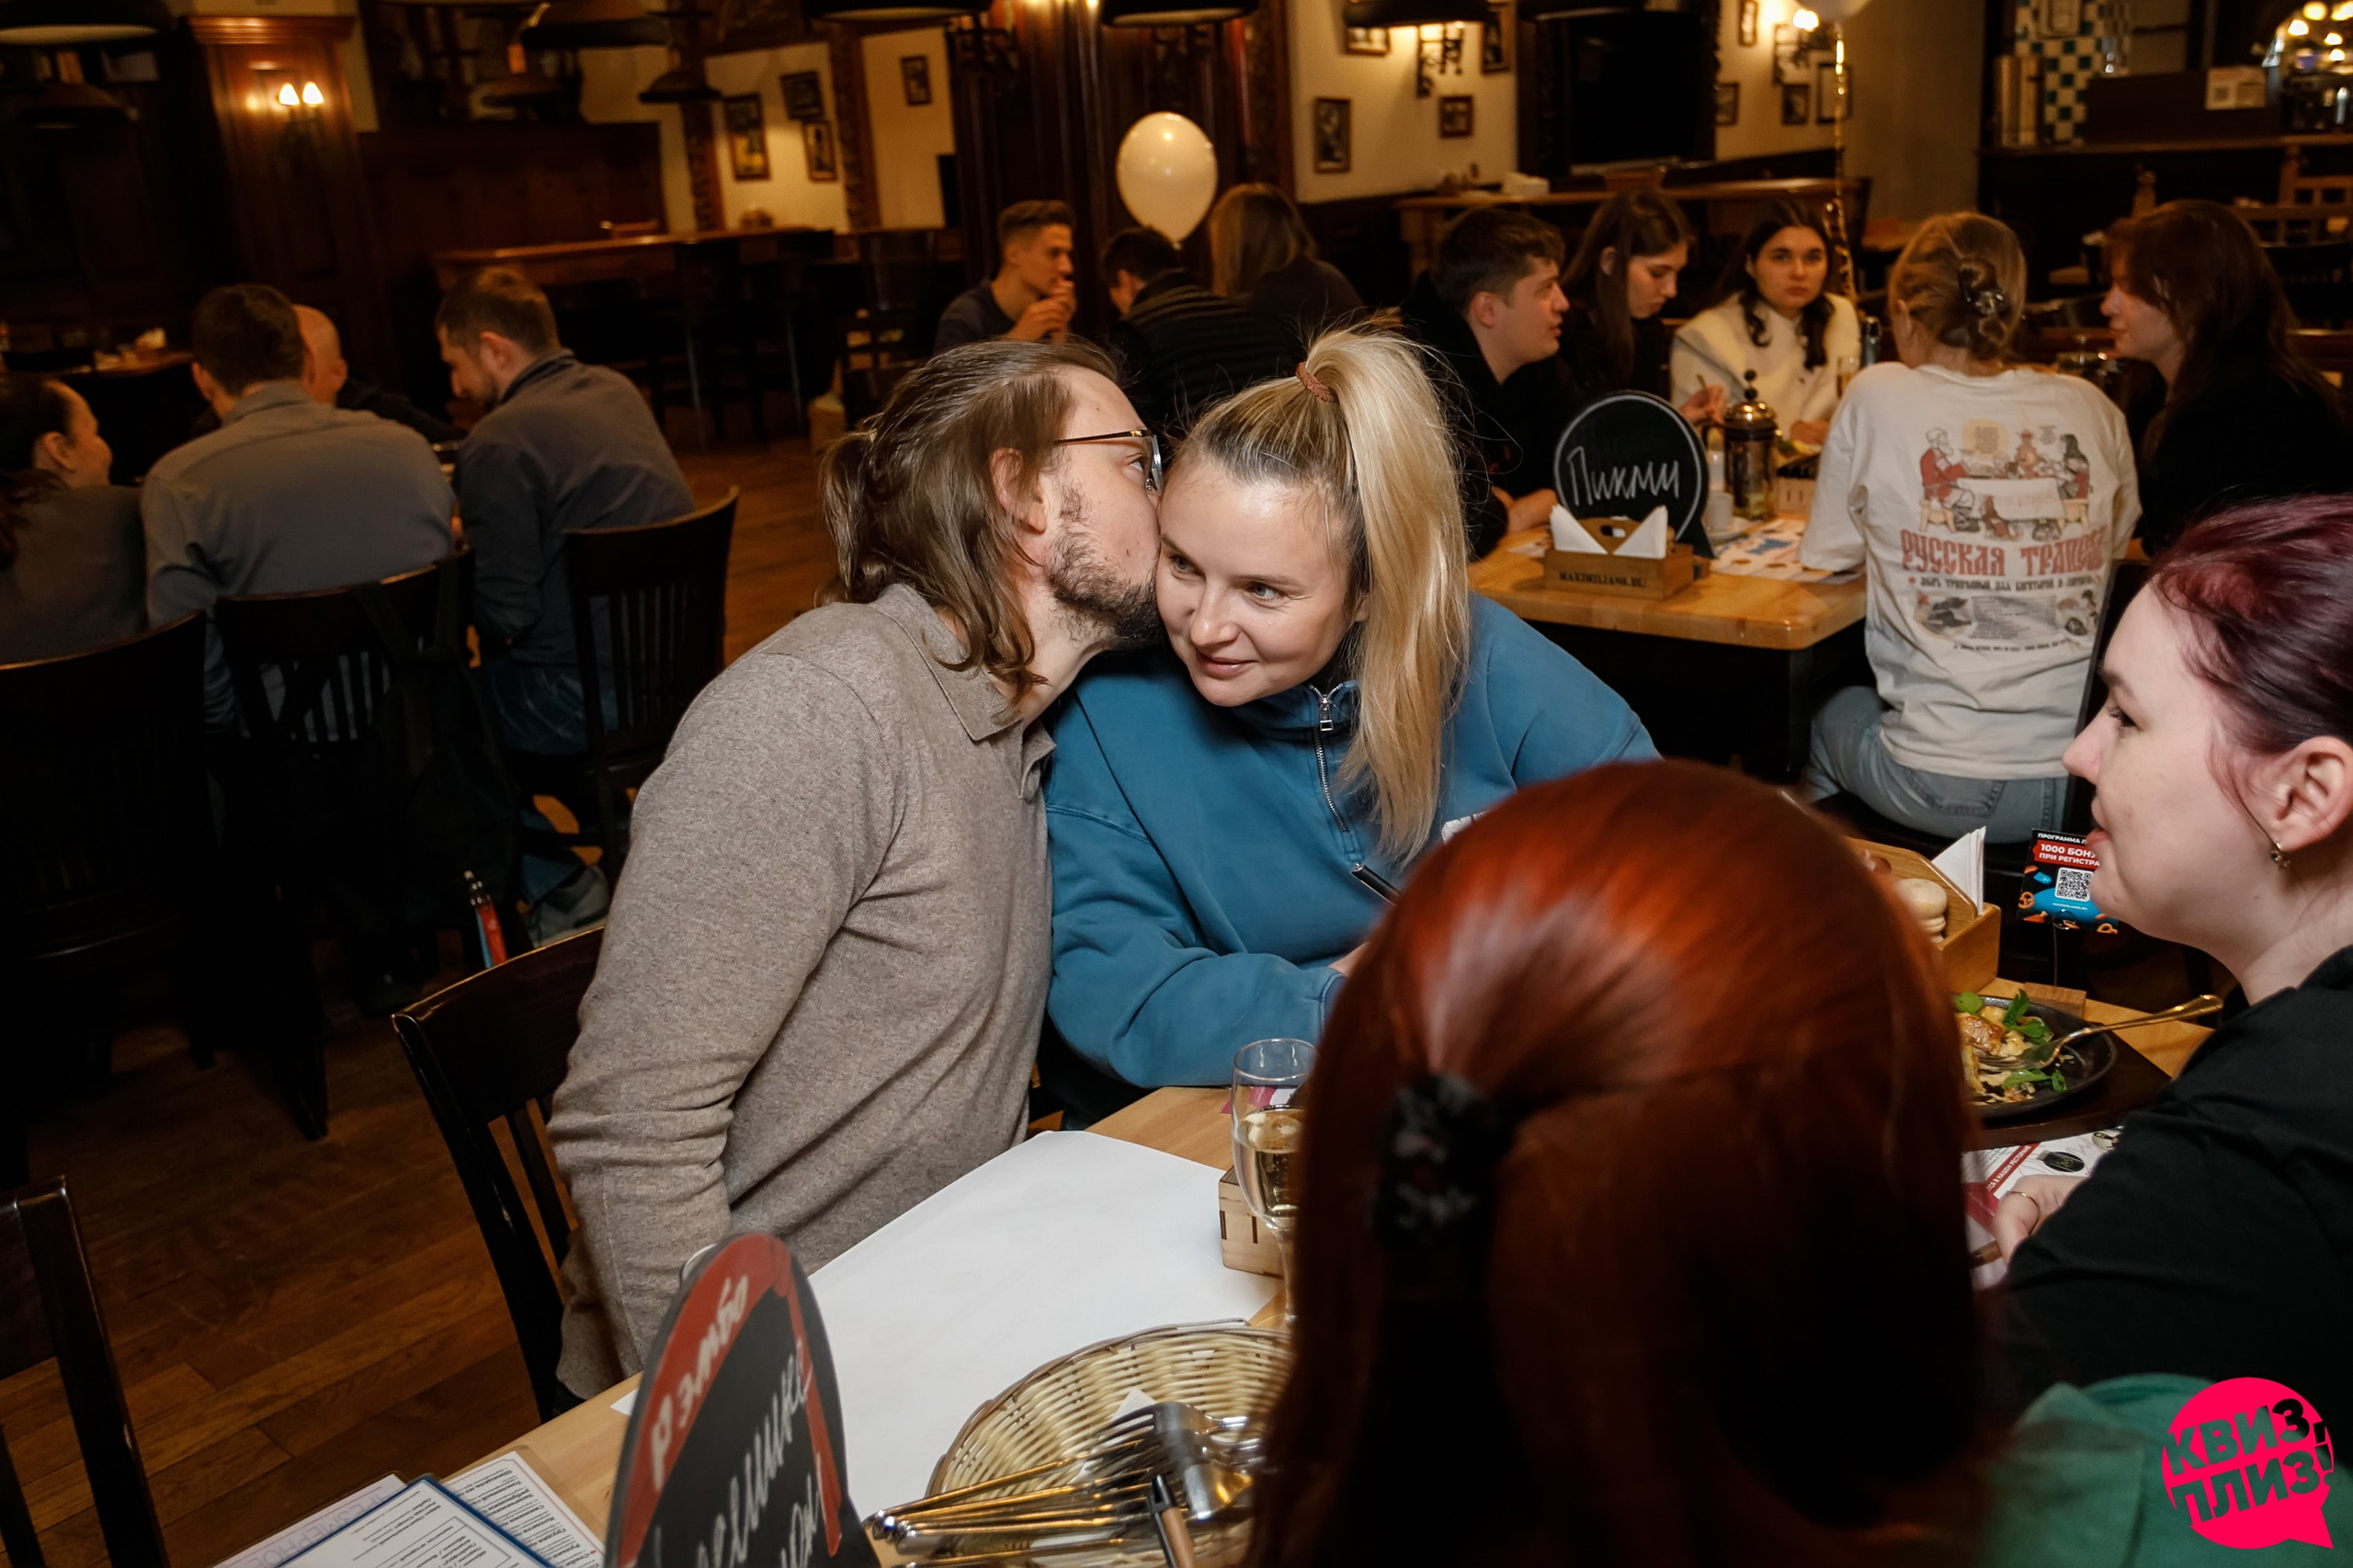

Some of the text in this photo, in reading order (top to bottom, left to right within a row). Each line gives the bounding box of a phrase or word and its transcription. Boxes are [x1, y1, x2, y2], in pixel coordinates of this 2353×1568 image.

[1567, 446, 1679, 506] Пикми
[1900, 528, 2006, 576] РУССКАЯ
[2038, 833, 2080, 844] ПРОГРАММА
[2040, 844, 2065, 854] 1000
[2039, 853, 2057, 861] ПРИ
